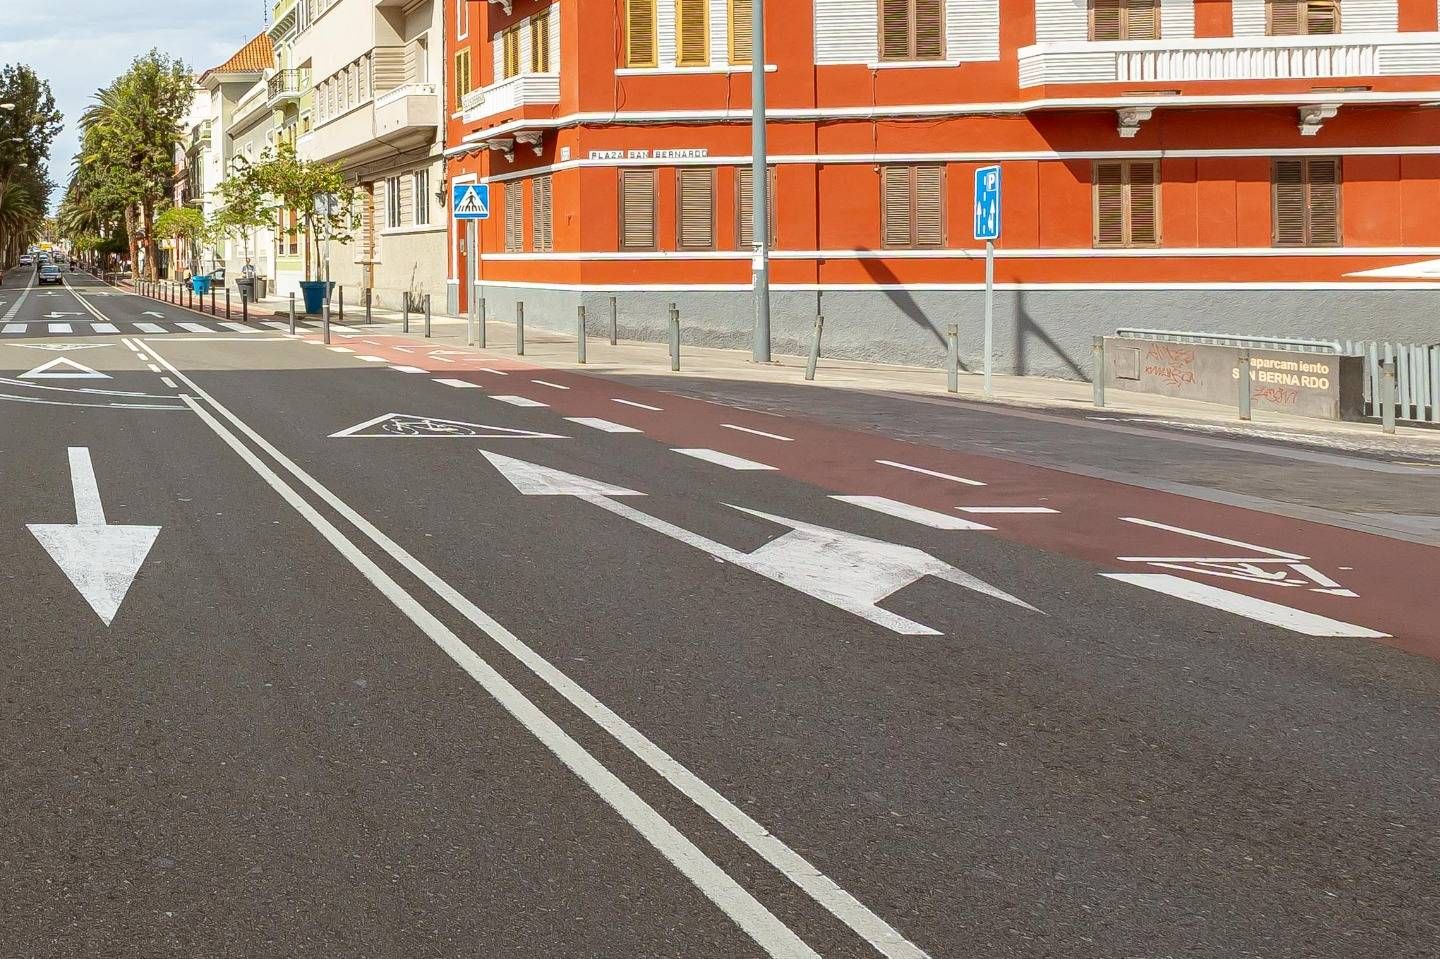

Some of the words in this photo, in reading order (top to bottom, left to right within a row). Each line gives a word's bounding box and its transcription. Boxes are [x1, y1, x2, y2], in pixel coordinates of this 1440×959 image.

[591, 151, 624, 159] PLAZA
[630, 151, 649, 159] SAN
[655, 150, 708, 159] BERNARDO
[988, 173, 996, 190] P
[1250, 358, 1329, 374] aparcamiento
[1232, 368, 1256, 381] SN
[1258, 371, 1330, 389] BERNARDO
